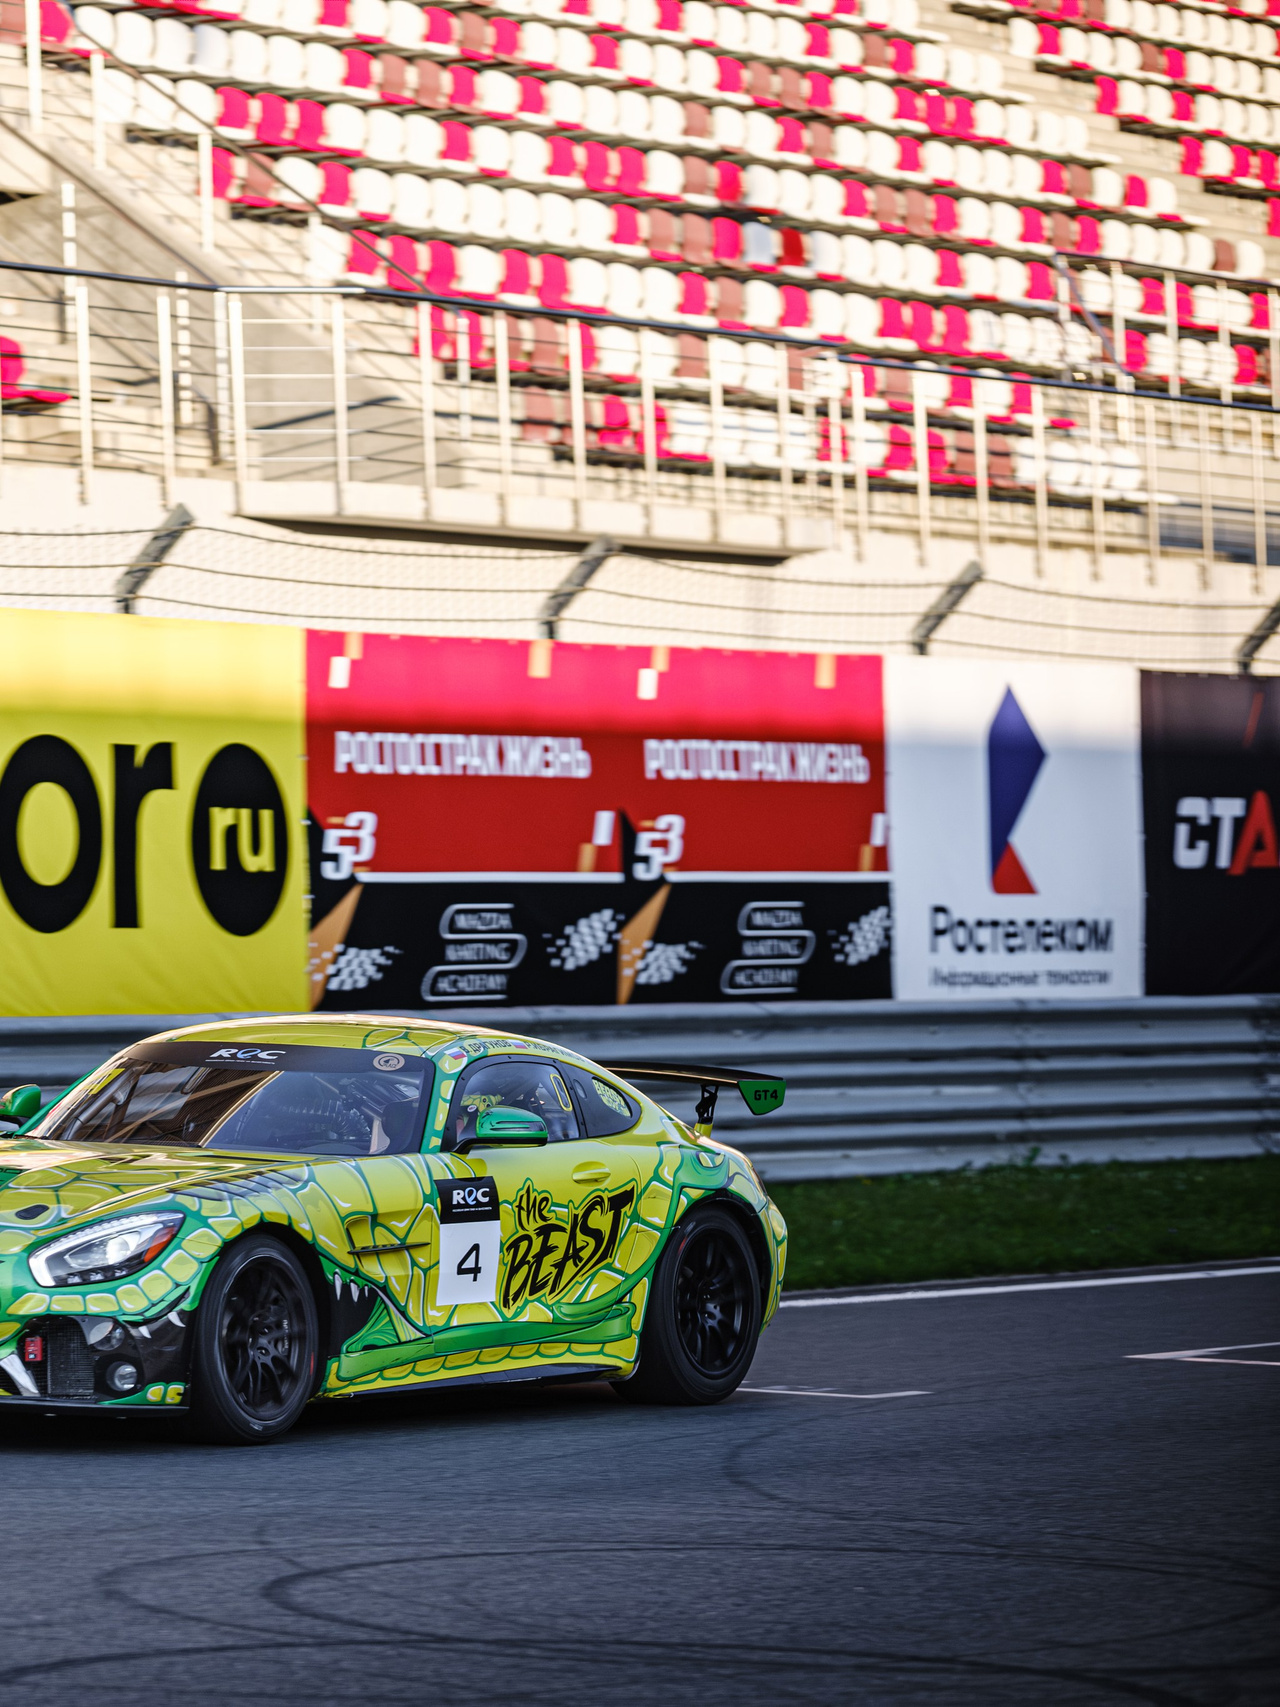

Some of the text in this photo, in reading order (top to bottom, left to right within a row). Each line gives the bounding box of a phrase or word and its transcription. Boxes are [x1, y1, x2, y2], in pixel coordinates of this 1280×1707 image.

[209, 807, 276, 872] ru
[320, 811, 378, 880] 53
[632, 815, 685, 881] 53
[930, 905, 1114, 954] Ростелеком
[754, 1089, 779, 1101] GT4
[456, 1242, 482, 1282] 4
[502, 1184, 635, 1310] BEAST
